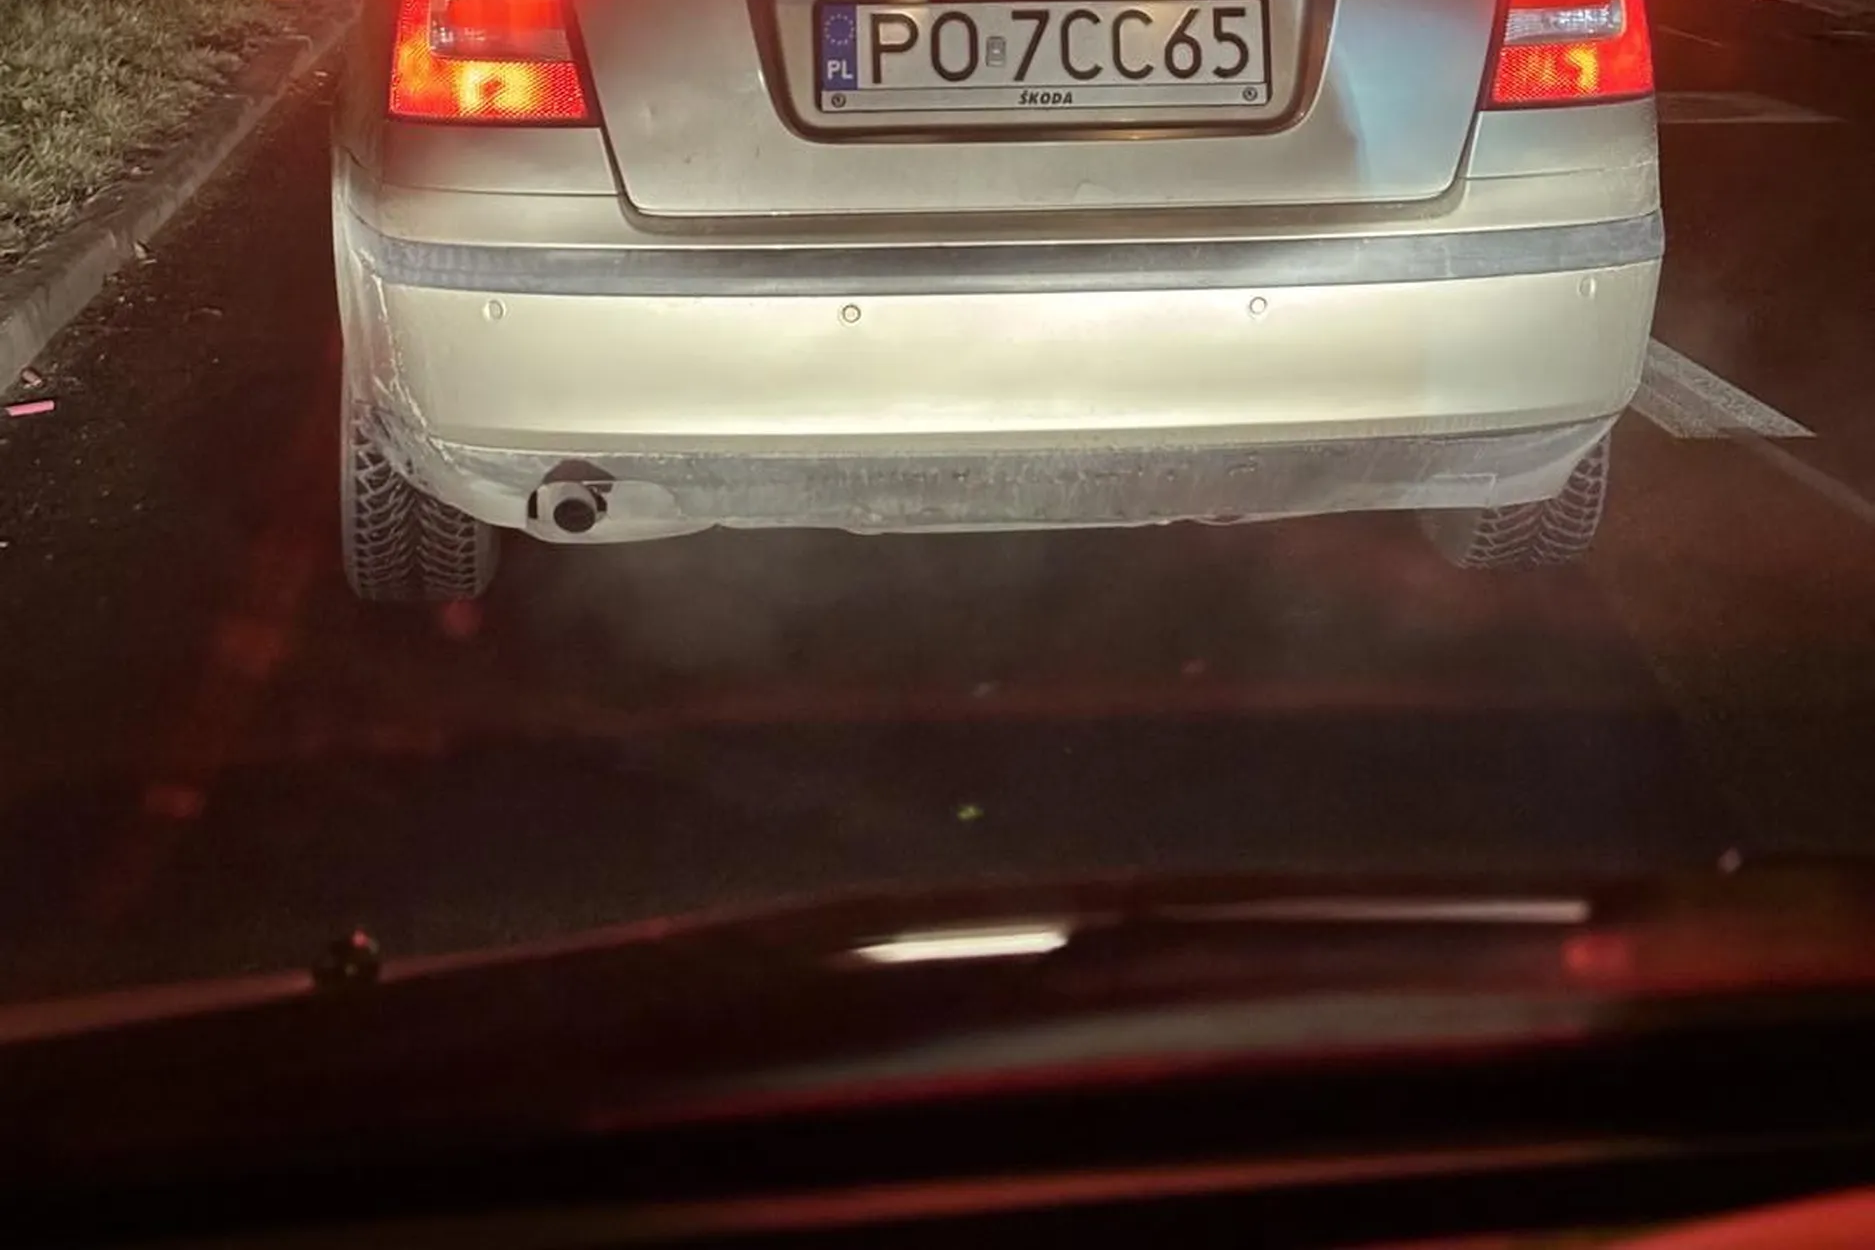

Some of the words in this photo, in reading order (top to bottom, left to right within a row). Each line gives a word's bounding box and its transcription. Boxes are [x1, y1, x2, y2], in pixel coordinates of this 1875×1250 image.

[870, 11, 979, 84] PO
[1011, 7, 1250, 82] 7CC65
[827, 60, 853, 80] PL
[1018, 90, 1073, 105] ŠKODA
